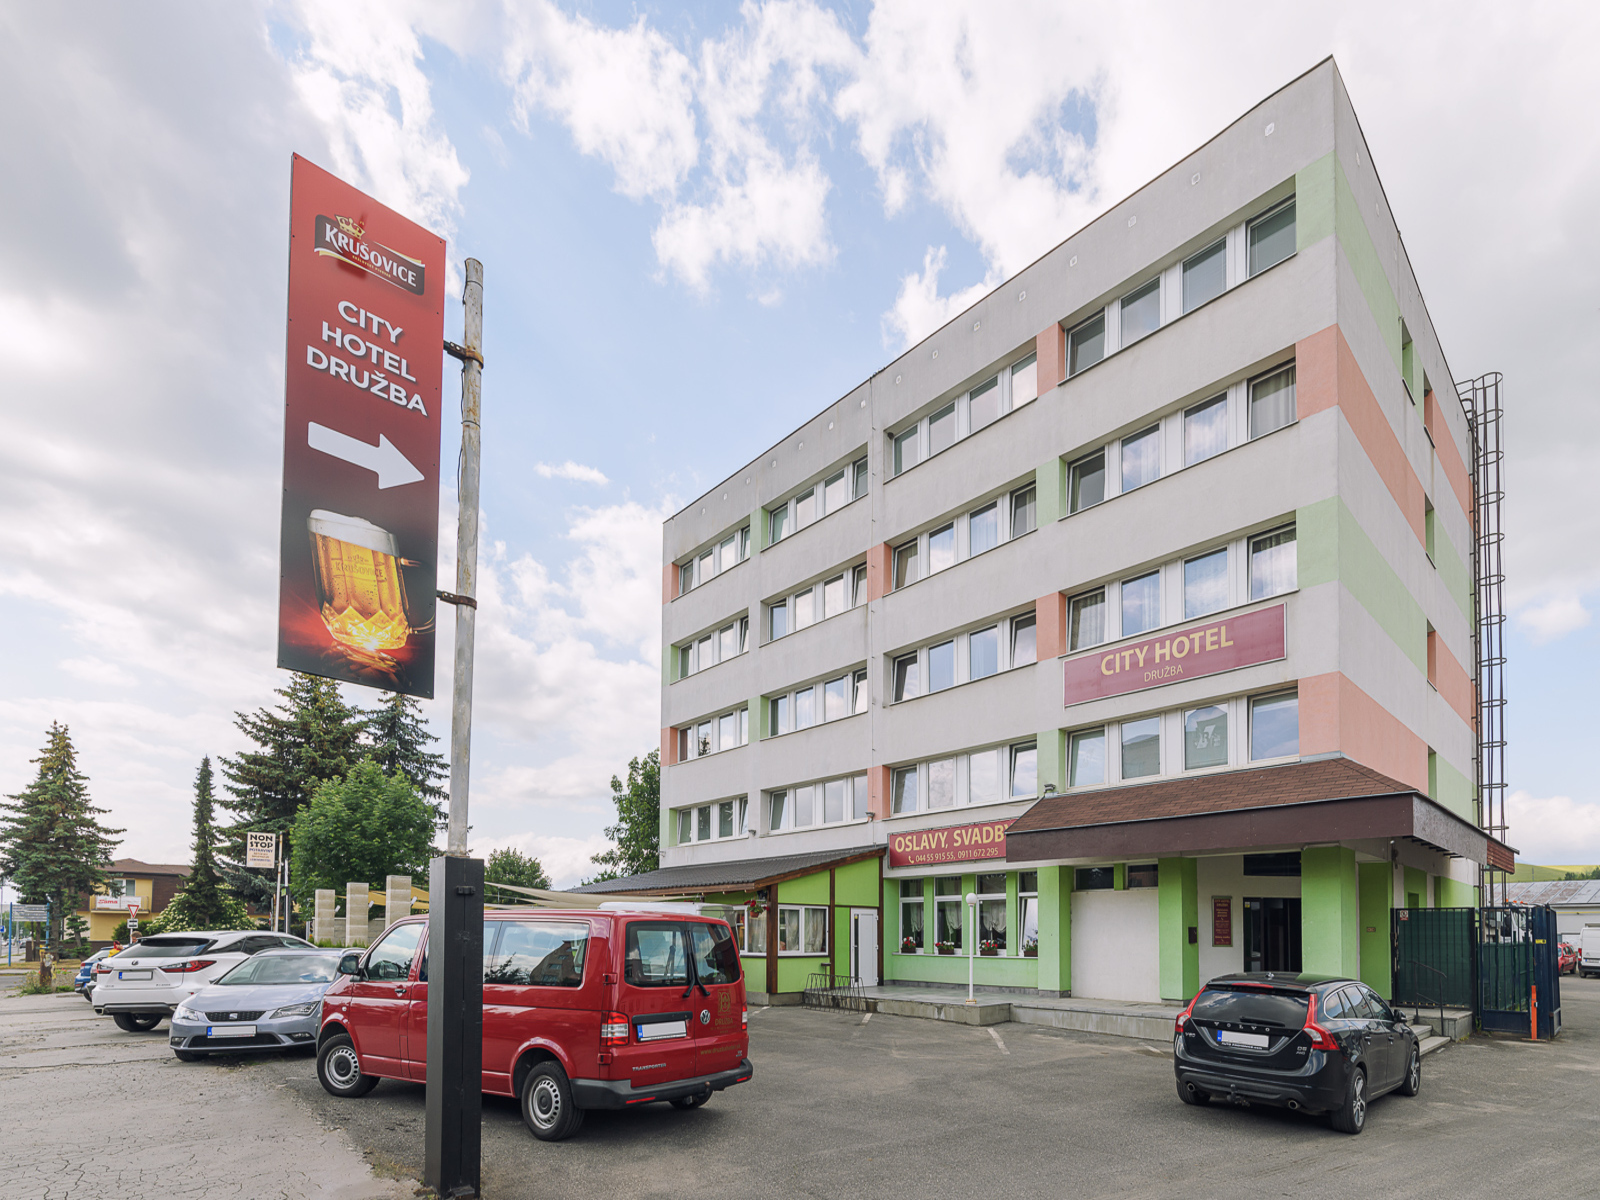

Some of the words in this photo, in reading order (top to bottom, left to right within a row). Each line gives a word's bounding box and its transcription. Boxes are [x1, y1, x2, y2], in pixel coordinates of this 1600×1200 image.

[325, 223, 417, 287] KRUŠOVICE
[338, 300, 404, 344] CITY
[322, 320, 417, 383] HOTEL
[306, 344, 428, 417] DRUŽBA
[1100, 645, 1149, 676] CITY
[1154, 625, 1234, 664] HOTEL
[1144, 664, 1184, 682] DRUŽBA
[250, 834, 273, 842] NON
[895, 831, 949, 853] OSLAVY,
[915, 854, 926, 863] 044
[926, 853, 934, 862] 55
[934, 852, 945, 861] 915
[957, 849, 972, 859] 0911
[973, 848, 986, 857] 672
[986, 847, 999, 857] 295
[1214, 1021, 1271, 1032] VOLVO
